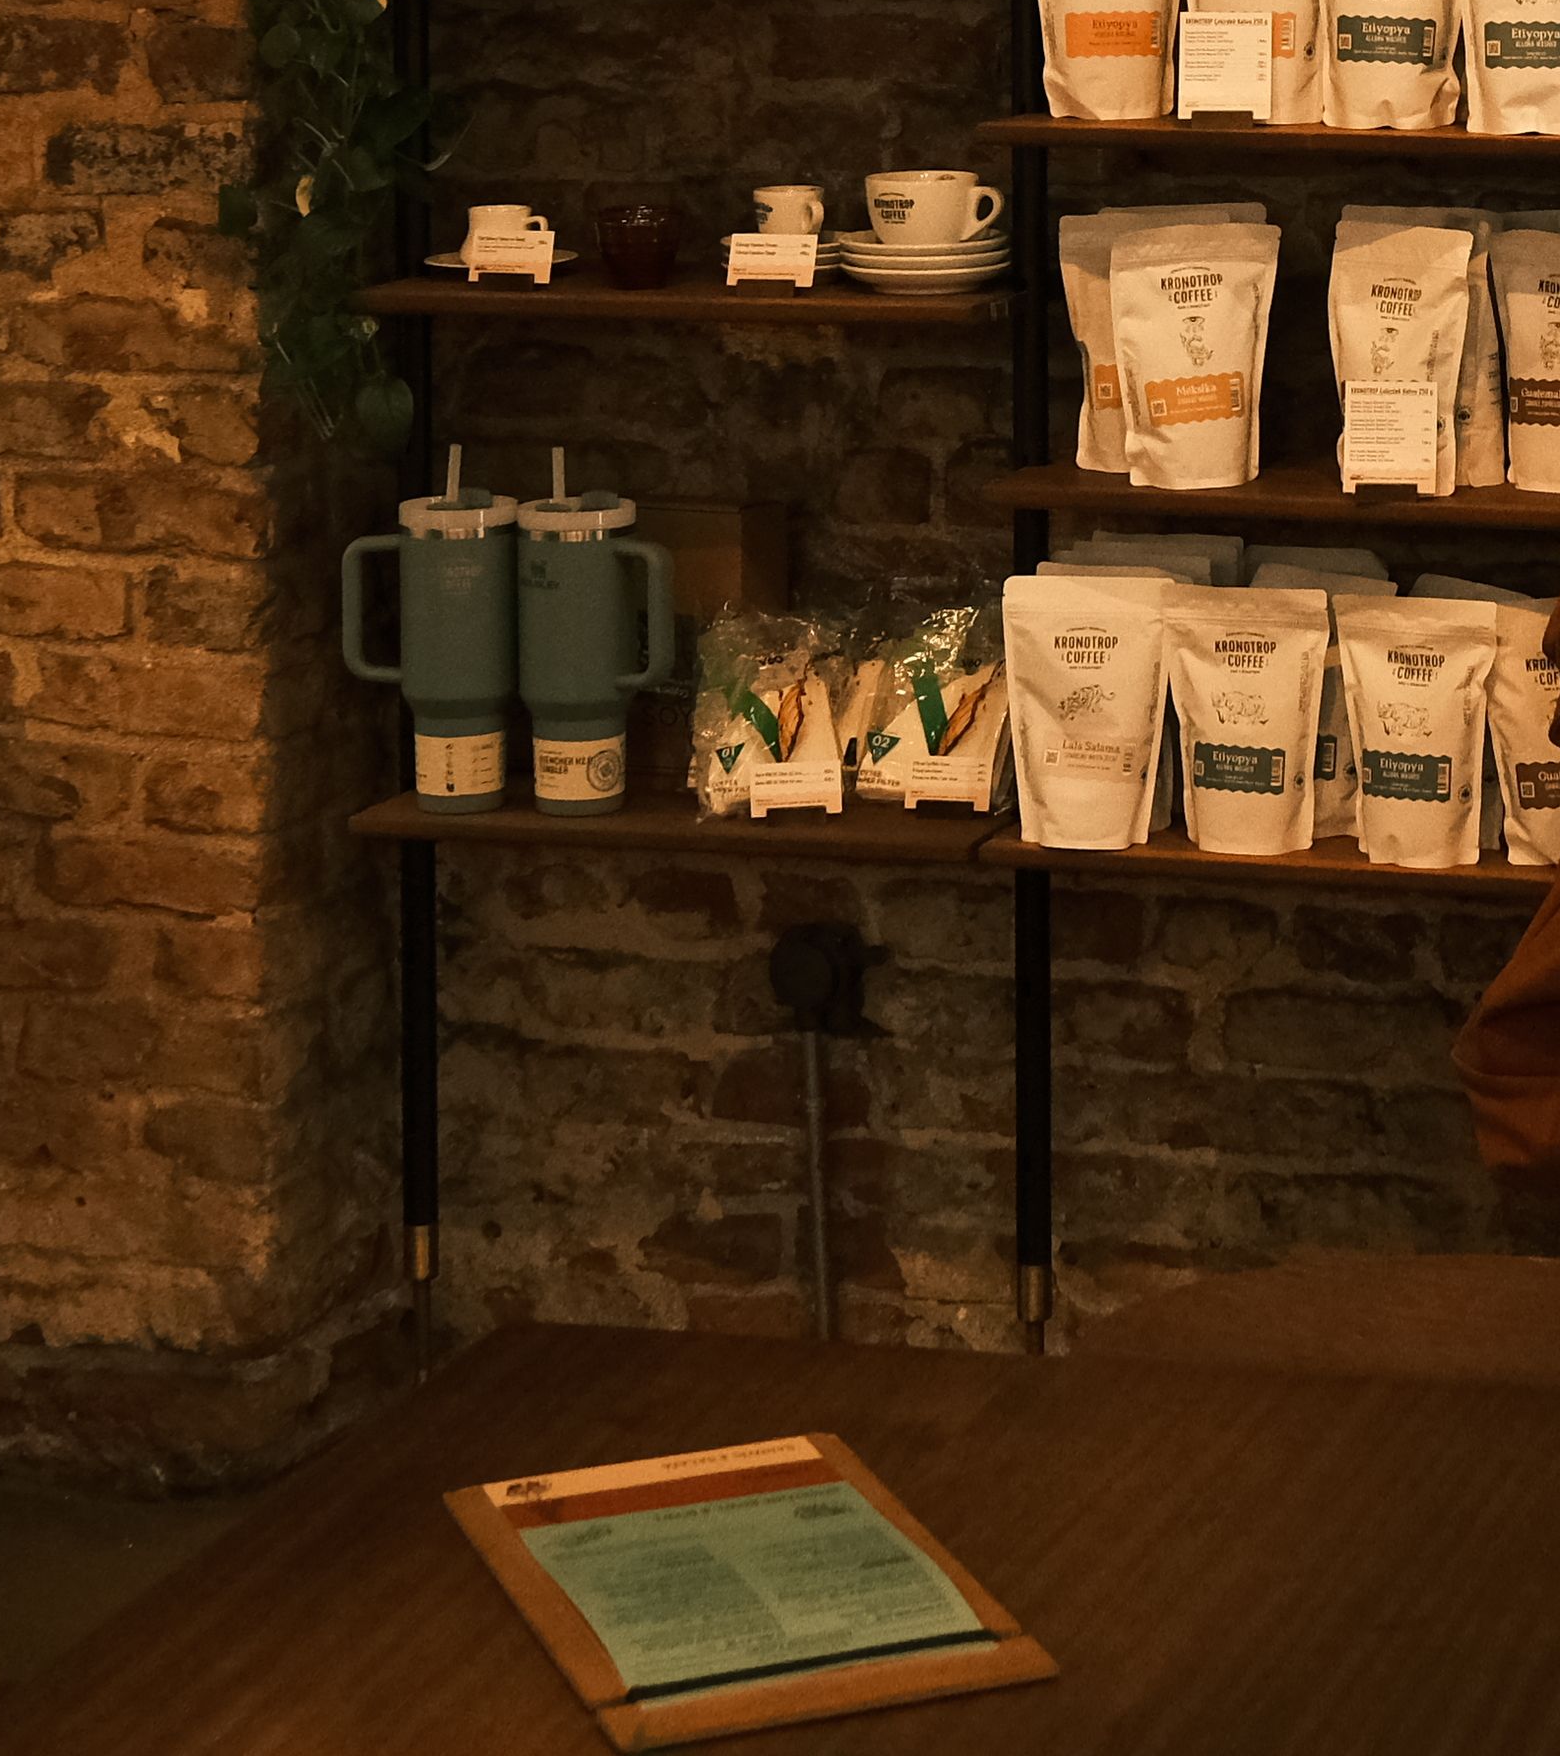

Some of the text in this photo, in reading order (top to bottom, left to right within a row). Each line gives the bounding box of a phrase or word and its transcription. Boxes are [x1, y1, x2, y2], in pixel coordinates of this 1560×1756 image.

[1361, 21, 1411, 36] Etiyopya
[1511, 27, 1560, 41] Etiyopya
[1160, 273, 1223, 290] KRONOTROP
[1173, 288, 1213, 304] COFFEE
[1370, 284, 1422, 302] KRONOTROP
[1379, 302, 1413, 317] COFFEE
[1054, 635, 1119, 649] KRONOTROP
[1214, 640, 1276, 655] KRONOTROP
[1065, 650, 1106, 665] COFFEE
[1227, 654, 1265, 669] COFFEE
[1387, 649, 1445, 669] KRONOTROP
[1396, 666, 1433, 683] COFFEE
[872, 735, 891, 749] 02
[1212, 750, 1258, 765] Etiyopya
[1379, 758, 1424, 773] Etiyopya
